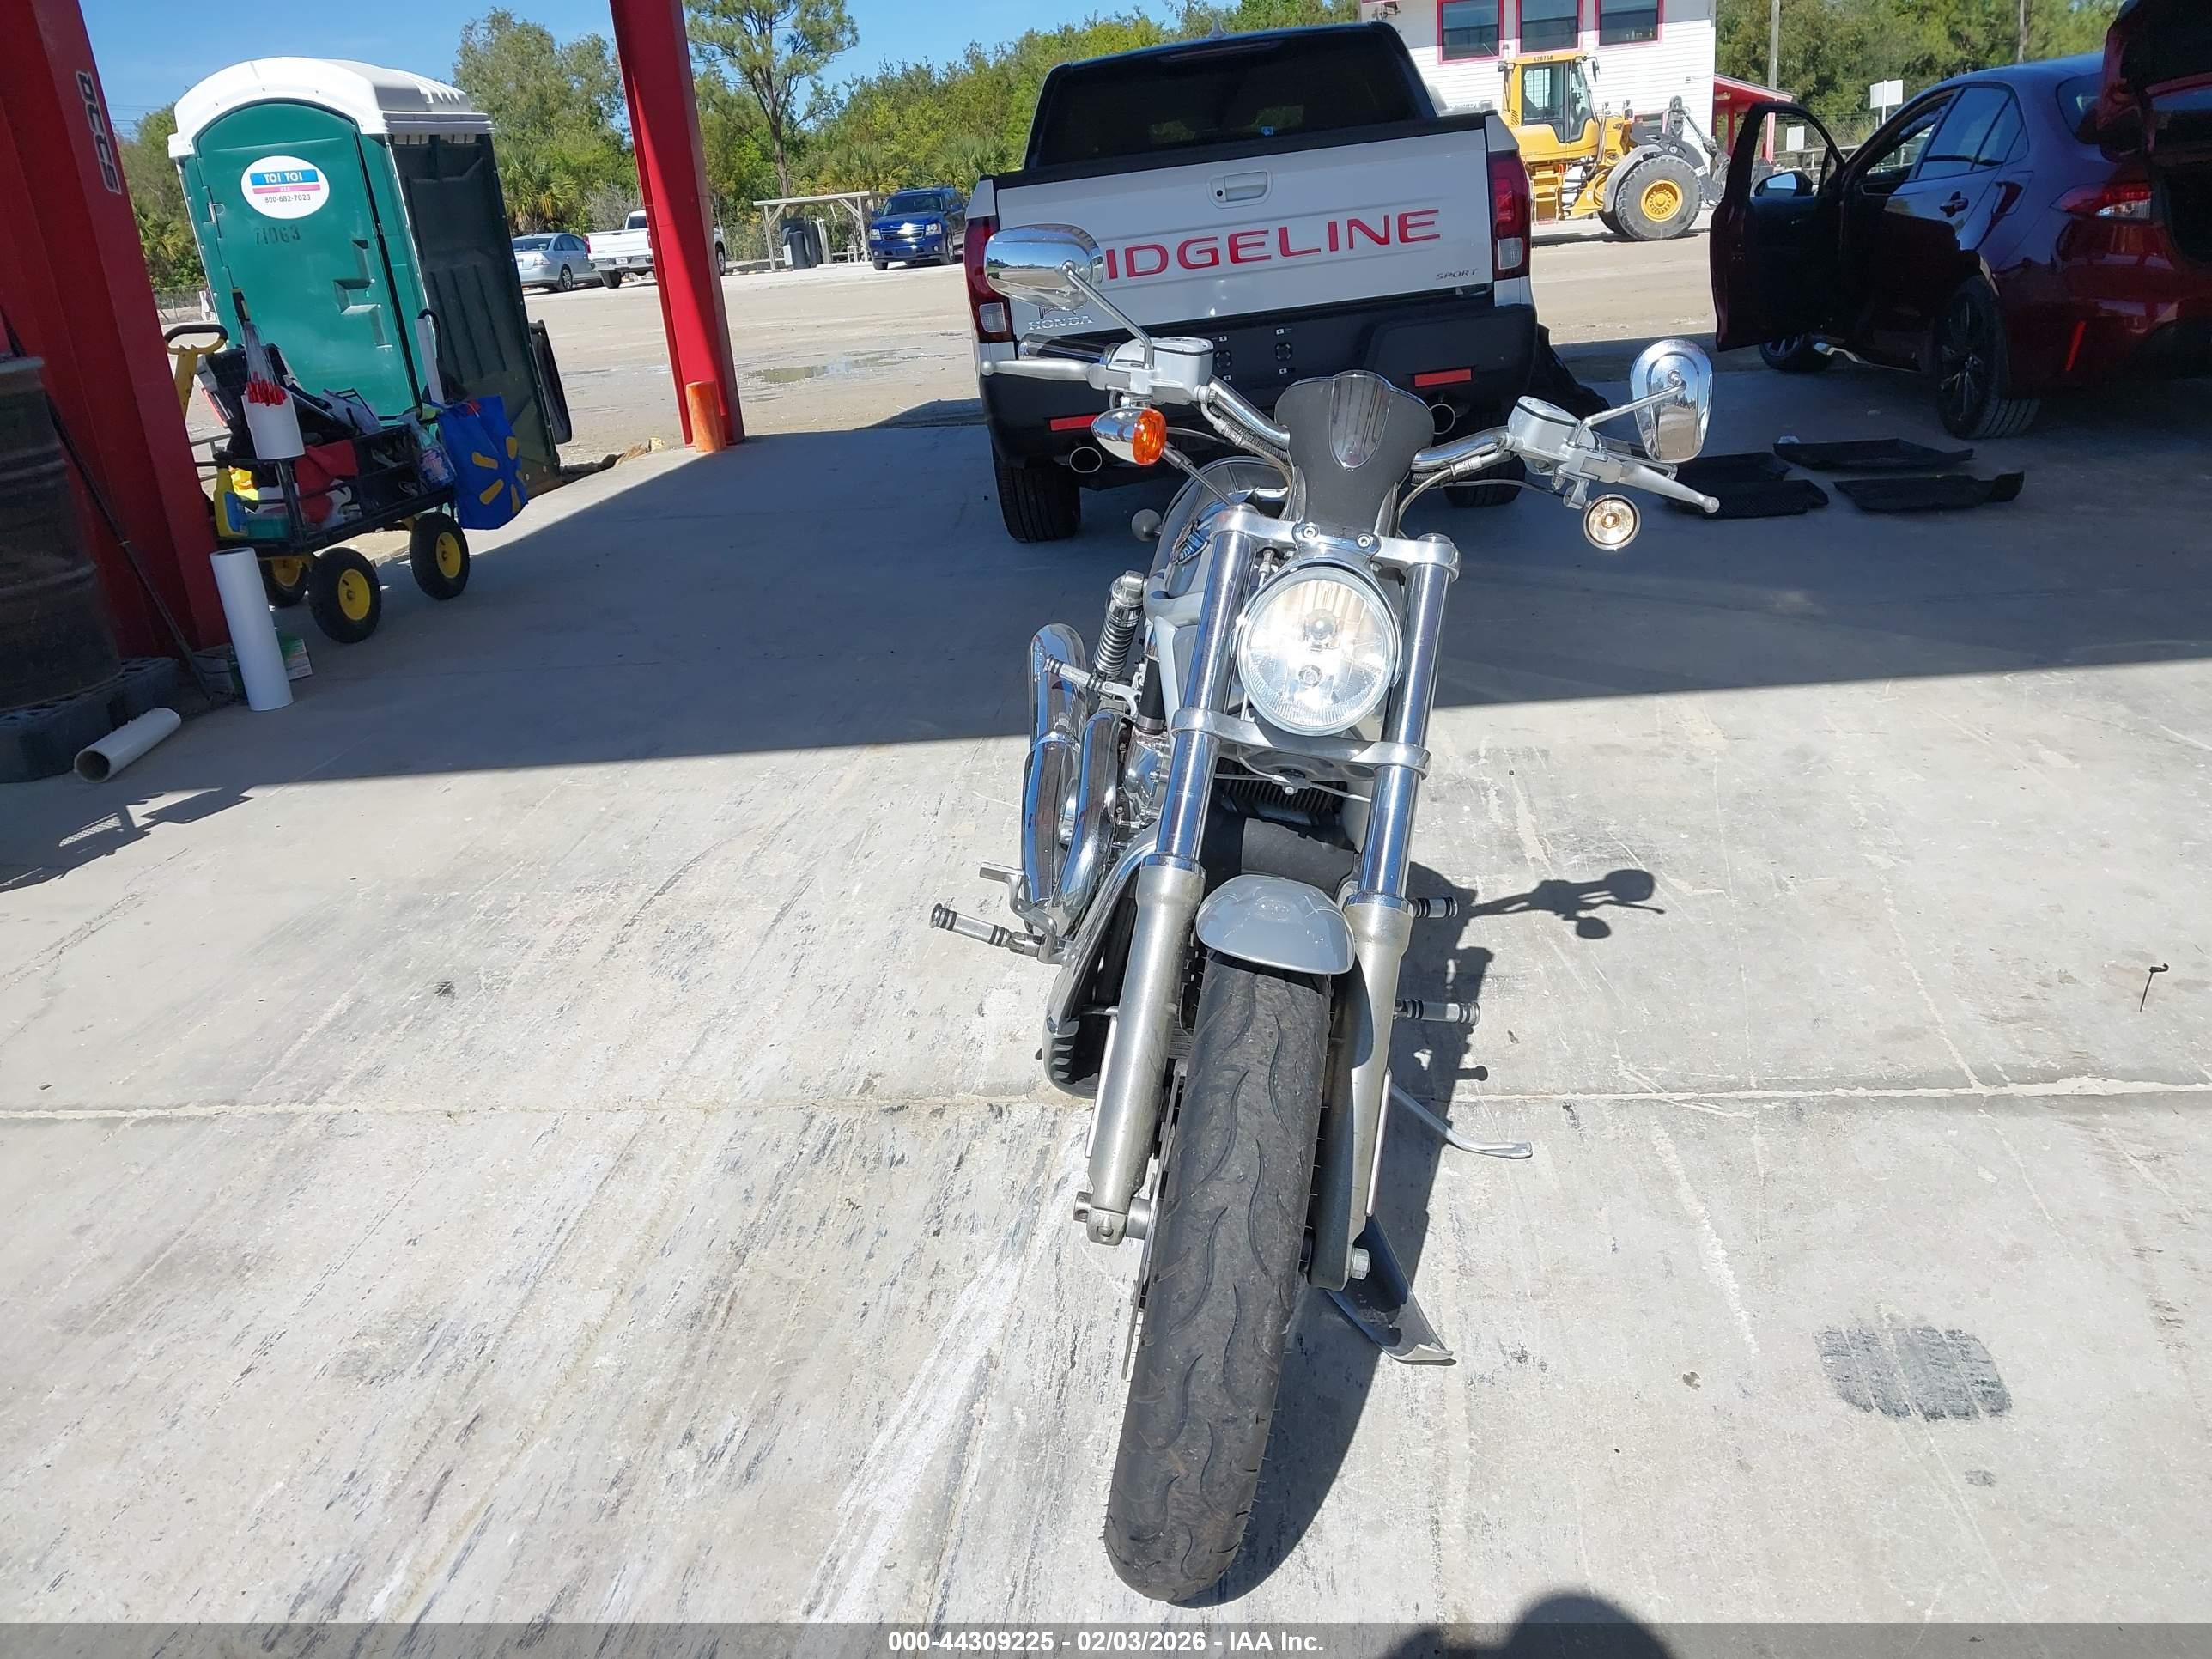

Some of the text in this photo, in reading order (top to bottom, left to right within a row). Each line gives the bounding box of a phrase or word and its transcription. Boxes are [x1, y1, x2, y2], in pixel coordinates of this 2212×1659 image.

[264, 171, 303, 184] TOI TOI
[265, 194, 311, 203] 800-682-7023
[1106, 209, 1441, 279] IDGELINE
[1436, 268, 1479, 280] SPORT
[1028, 315, 1094, 331] HONDA
